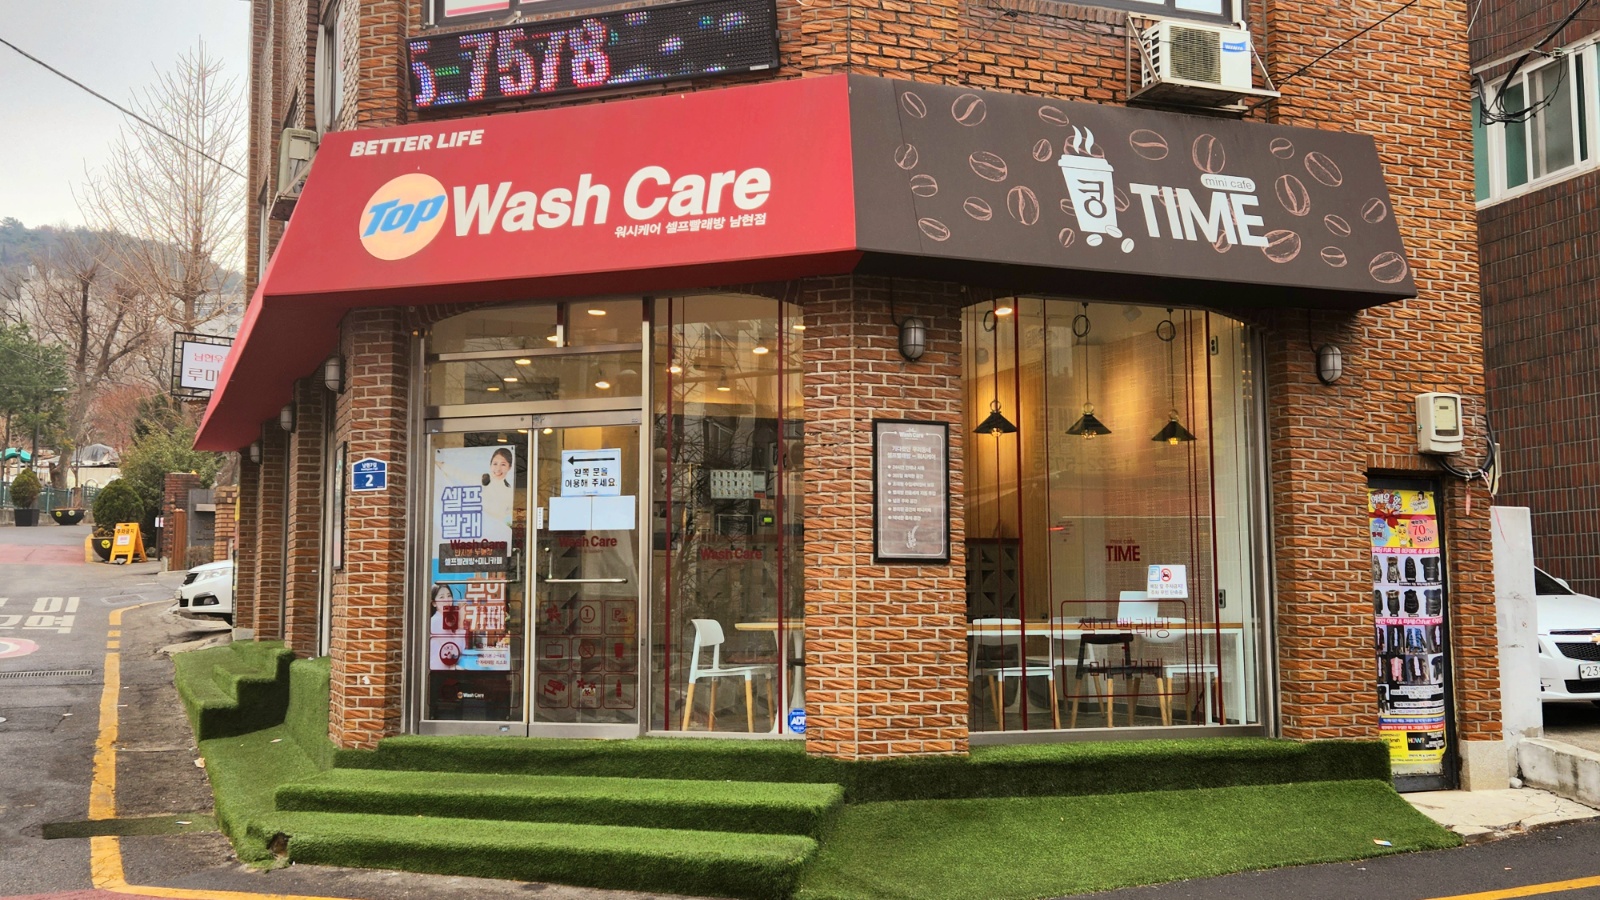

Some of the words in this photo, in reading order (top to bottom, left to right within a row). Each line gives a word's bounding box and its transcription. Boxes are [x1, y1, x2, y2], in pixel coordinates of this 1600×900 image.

[350, 134, 434, 157] BETTER
[436, 129, 485, 149] LIFE
[1205, 176, 1228, 188] mini
[1230, 179, 1252, 190] cafe
[362, 195, 446, 238] Top
[453, 173, 611, 237] Wash
[623, 165, 771, 221] Care
[1129, 182, 1270, 248] TIME
[614, 222, 662, 238] 워시케어
[665, 216, 726, 234] 셀프빨래방
[729, 212, 767, 228] 남현점
[574, 468, 590, 477] 왼쪽
[593, 467, 608, 476] 문을
[365, 474, 374, 487] 2
[565, 479, 588, 488] 이용해
[442, 486, 482, 512] 셀프
[442, 511, 482, 539] 빨래
[559, 536, 589, 547] Wash
[590, 535, 617, 548] Care
[701, 548, 732, 560] Wash
[734, 547, 763, 560] Care
[1105, 545, 1140, 561] TIME
[1586, 665, 1600, 677] 23
[791, 716, 806, 726] ADT
